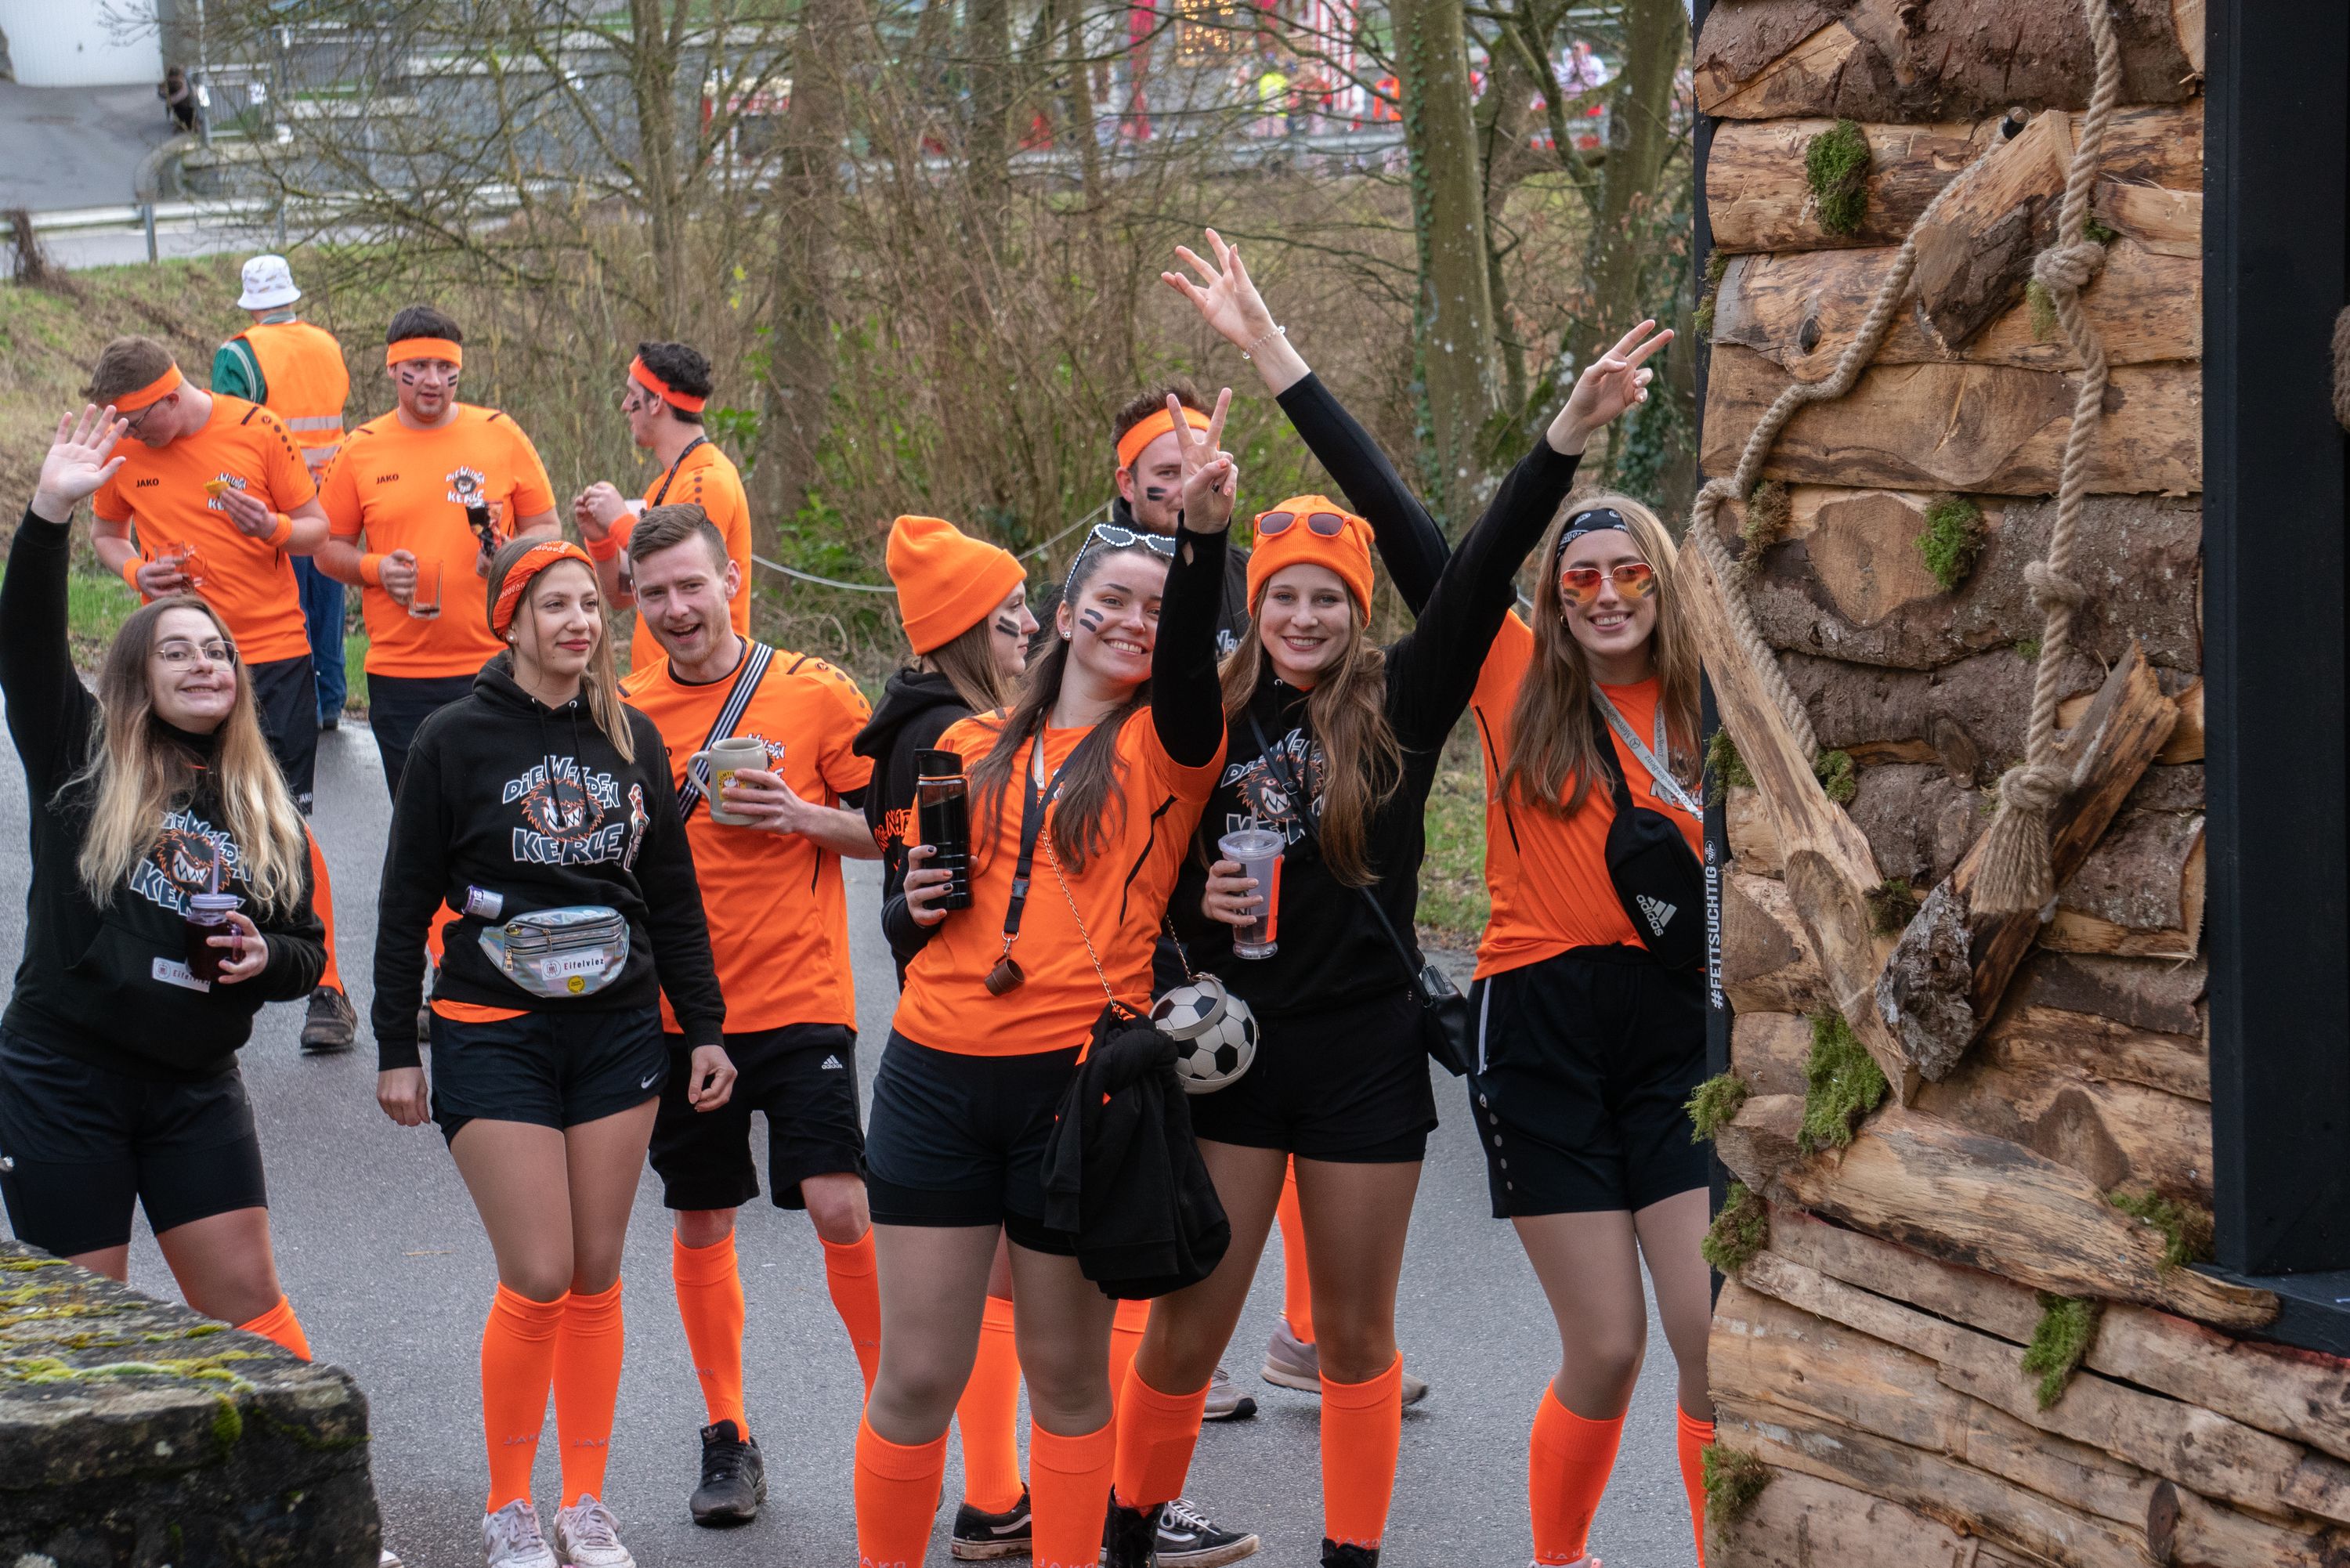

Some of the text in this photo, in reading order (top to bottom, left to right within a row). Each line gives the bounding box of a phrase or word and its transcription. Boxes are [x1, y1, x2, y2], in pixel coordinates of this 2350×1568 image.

[136, 478, 160, 488] JAKO
[376, 473, 400, 485] JAKO
[512, 823, 624, 866] KERLE
[1636, 894, 1664, 937] adidas
[1705, 865, 1723, 1010] #FETTSÜCHTIG
[564, 958, 605, 971] Eifelviez
[503, 1432, 541, 1446] JAK
[572, 1436, 610, 1448] JAK
